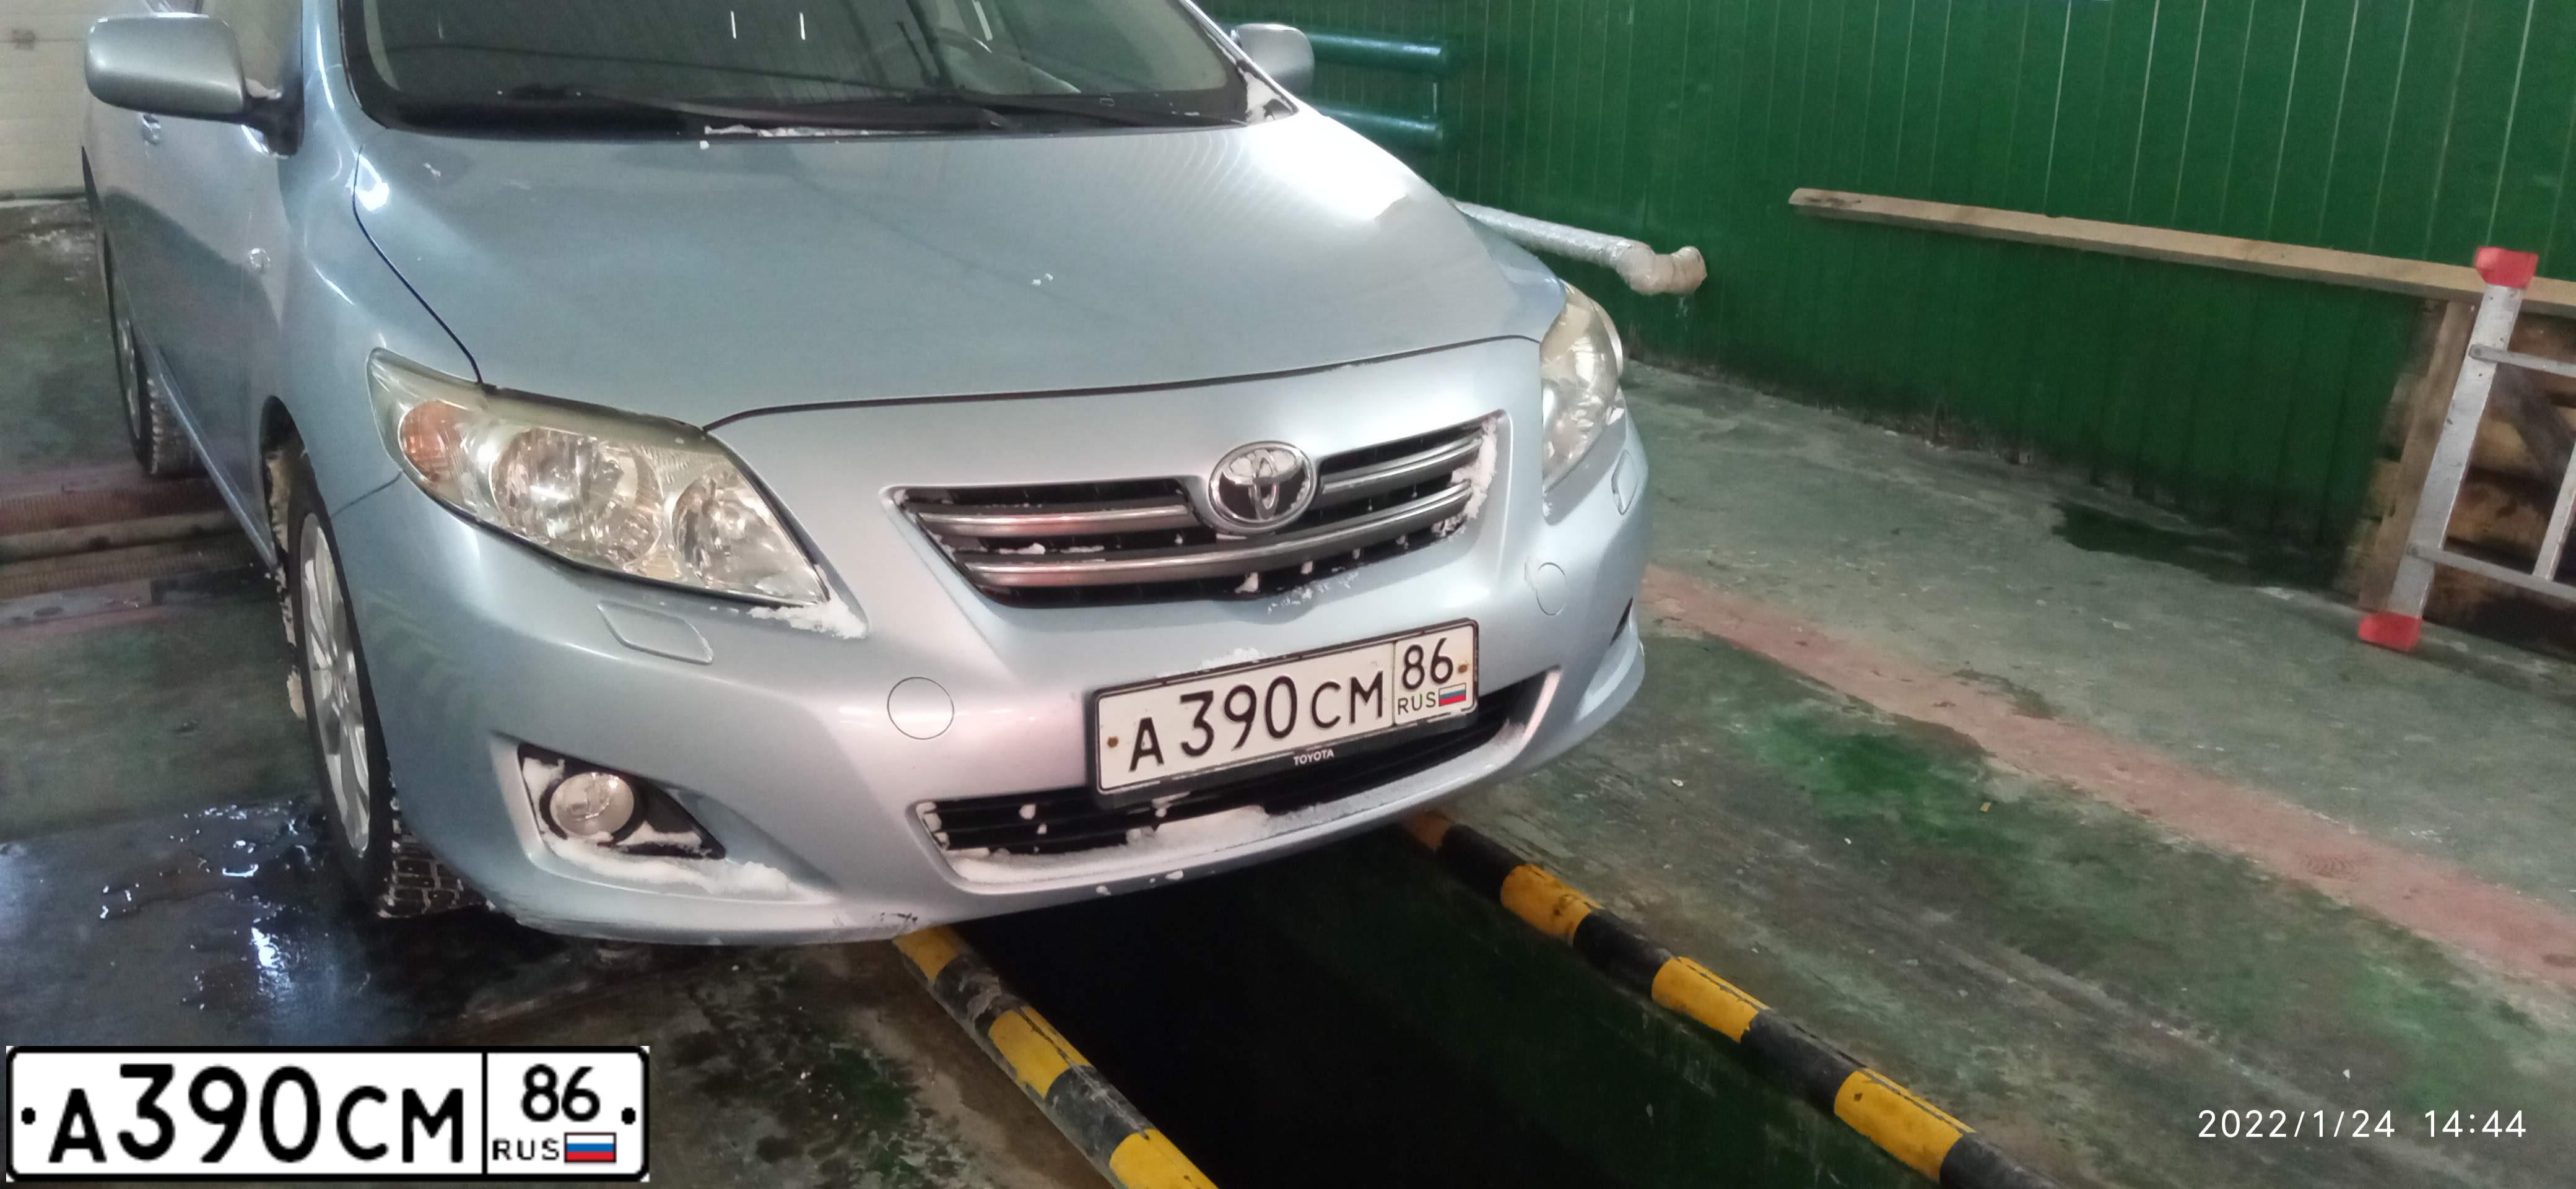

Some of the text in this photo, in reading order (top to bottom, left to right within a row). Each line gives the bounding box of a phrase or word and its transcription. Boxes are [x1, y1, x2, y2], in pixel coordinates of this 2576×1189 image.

[1401, 637, 1454, 690] 86
[1397, 690, 1437, 716] RUS
[1293, 748, 1334, 767] TOYOTA
